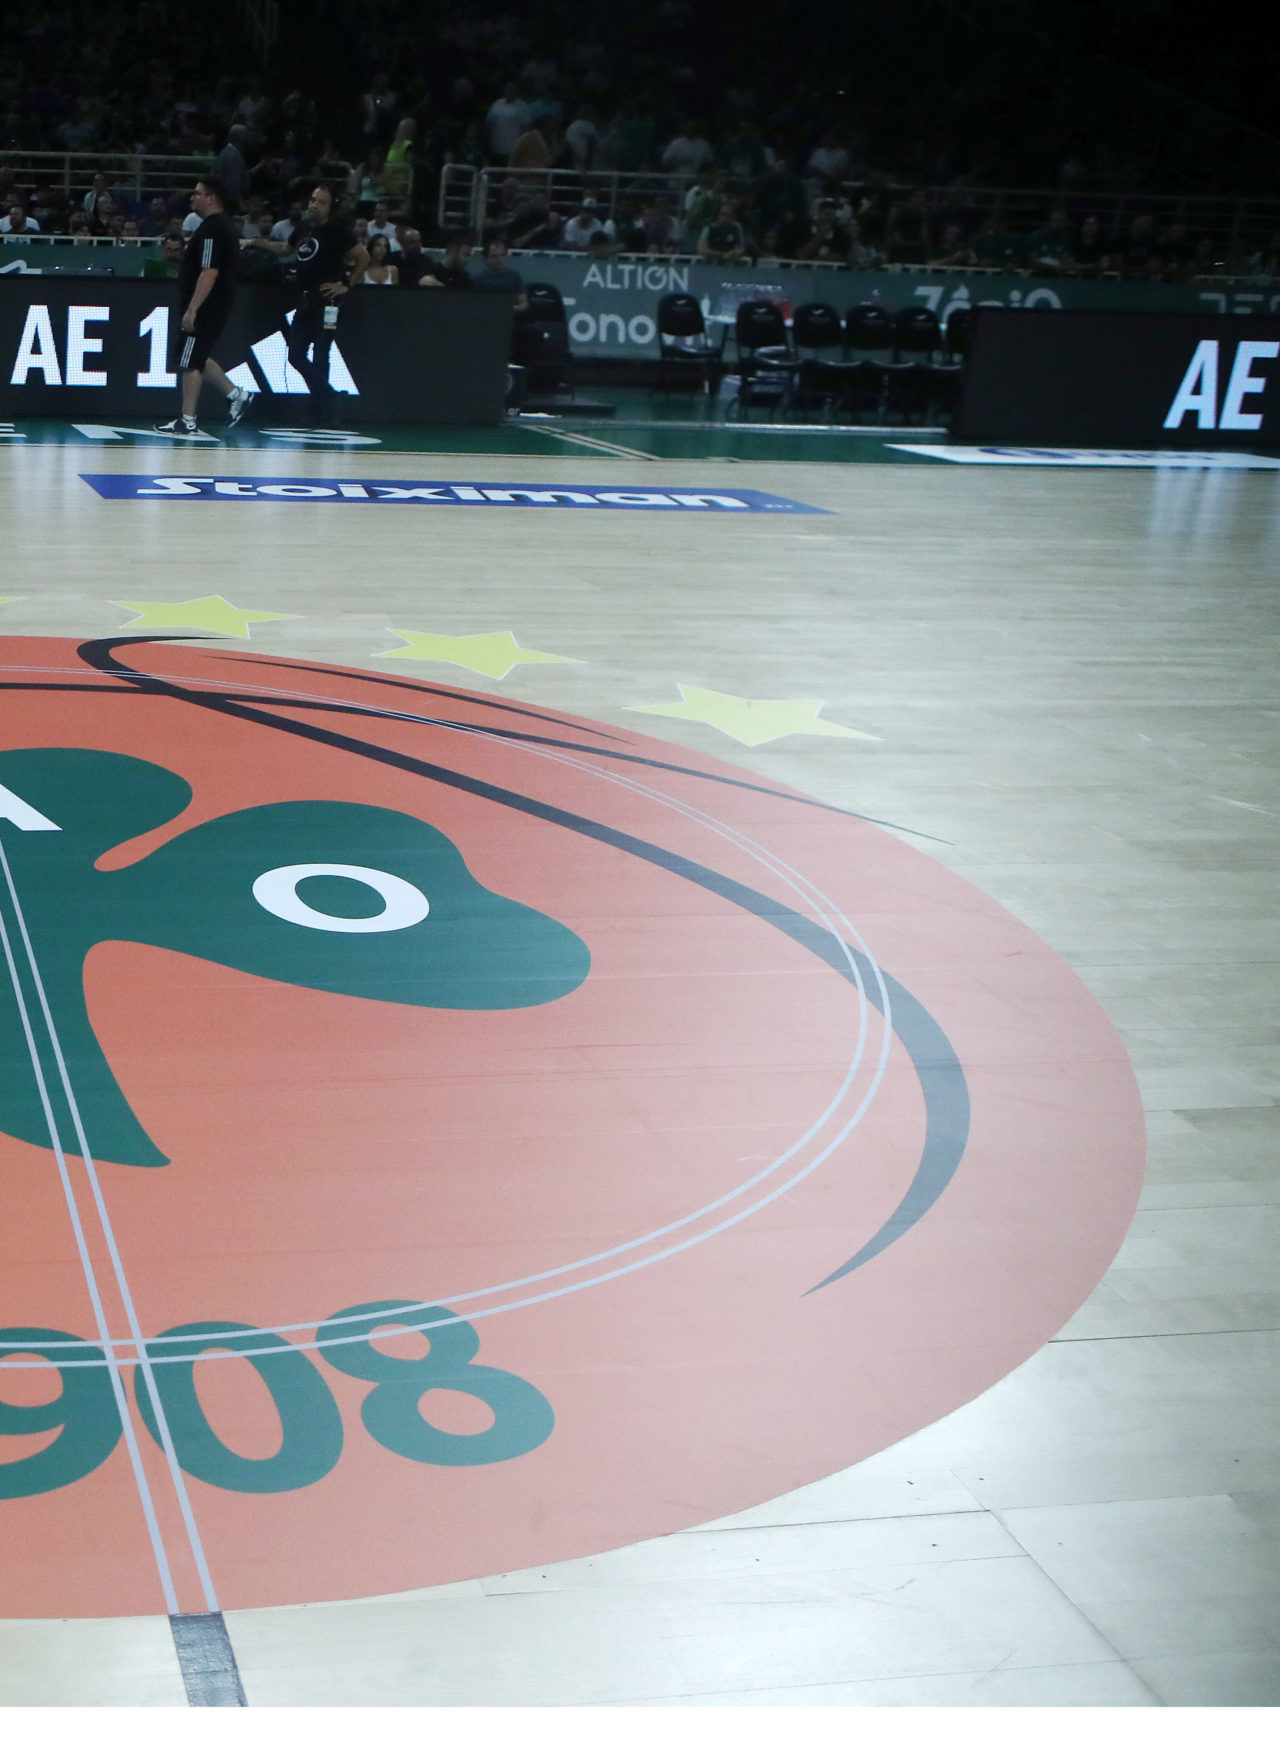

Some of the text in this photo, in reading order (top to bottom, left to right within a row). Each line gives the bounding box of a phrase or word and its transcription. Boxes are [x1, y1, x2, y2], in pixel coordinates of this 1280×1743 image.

[583, 263, 690, 292] ALTION
[10, 305, 177, 387] AE 1
[1162, 339, 1280, 430] AE
